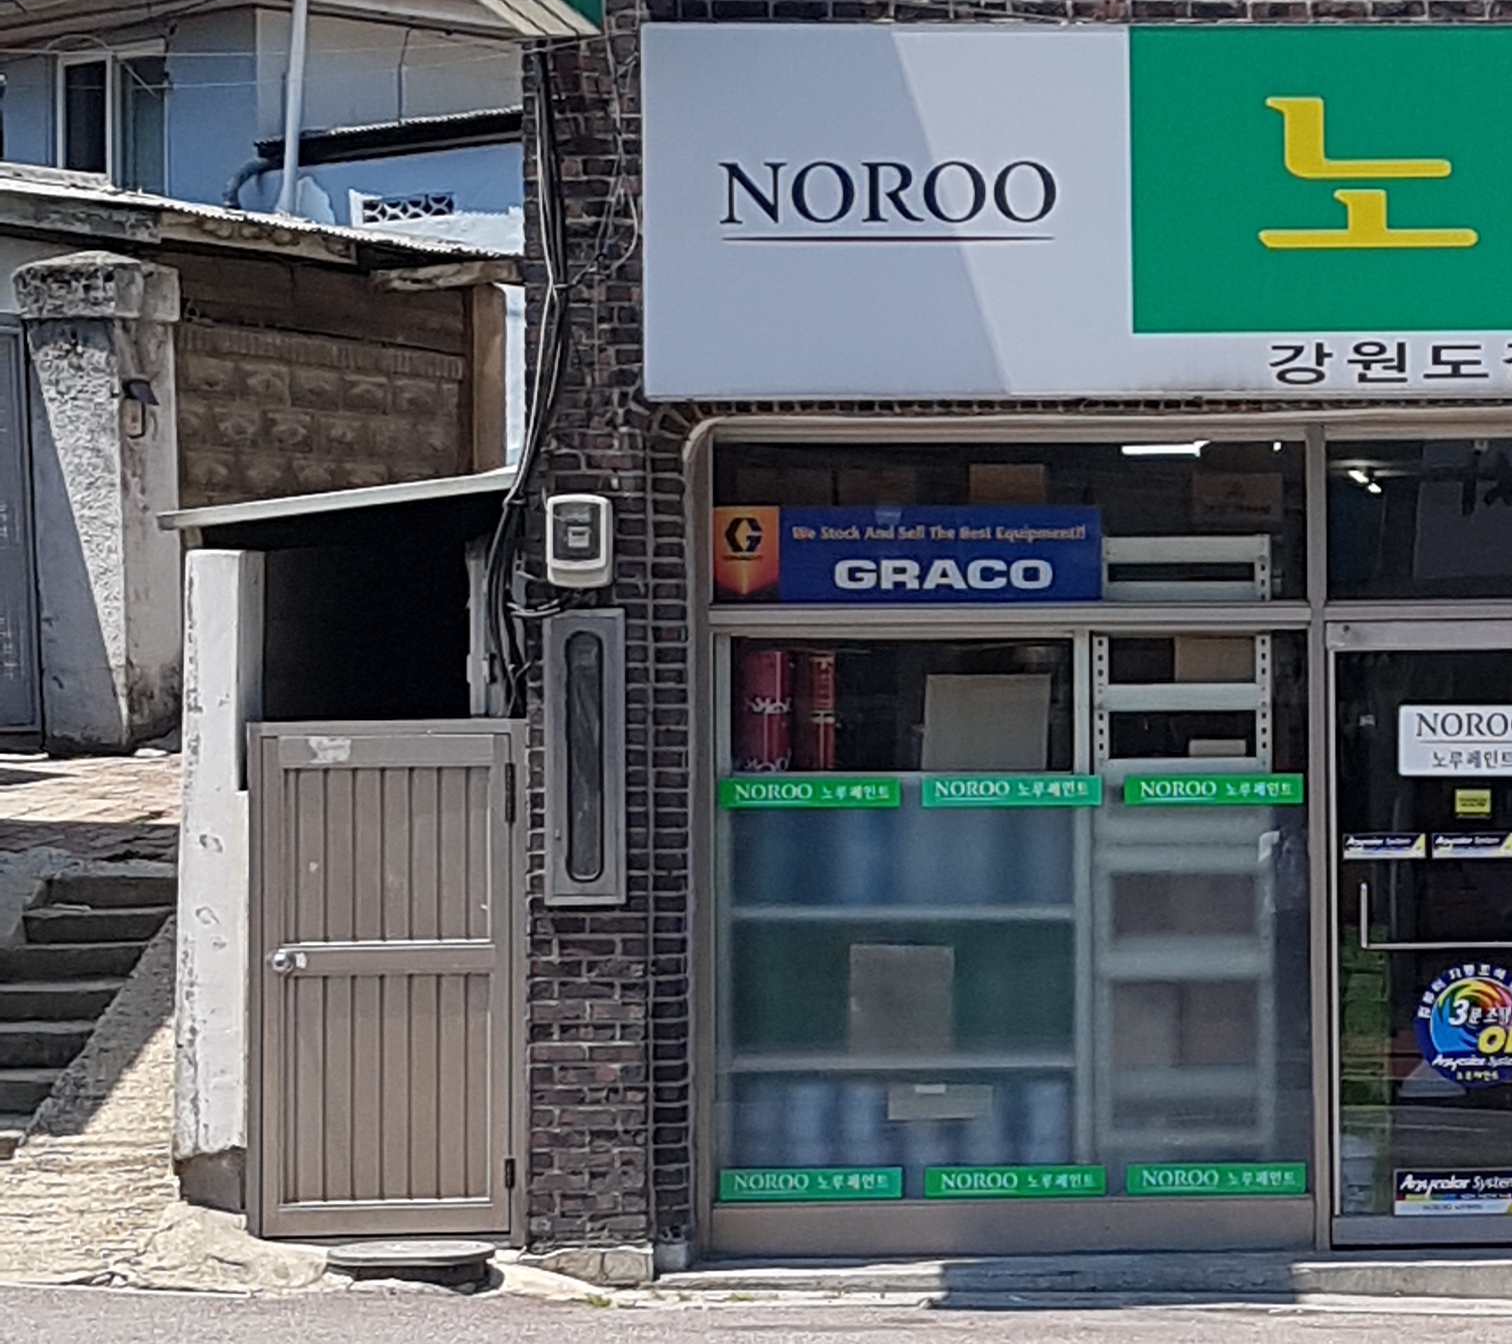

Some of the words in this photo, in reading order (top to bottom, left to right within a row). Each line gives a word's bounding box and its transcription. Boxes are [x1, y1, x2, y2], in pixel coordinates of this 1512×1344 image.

[718, 160, 1057, 225] NOROO
[820, 526, 860, 540] Stock
[864, 526, 896, 540] And
[898, 526, 925, 540] Sell
[929, 526, 955, 540] The
[834, 559, 1053, 590] GRACO
[735, 782, 813, 800] NOROO
[935, 780, 1010, 797] NOROO
[1140, 780, 1217, 797] NOROO
[733, 1172, 809, 1189] NOROO
[940, 1172, 1017, 1189] NOROO
[1142, 1169, 1219, 1186] NOROO
[1400, 1174, 1471, 1197] Anycolor
